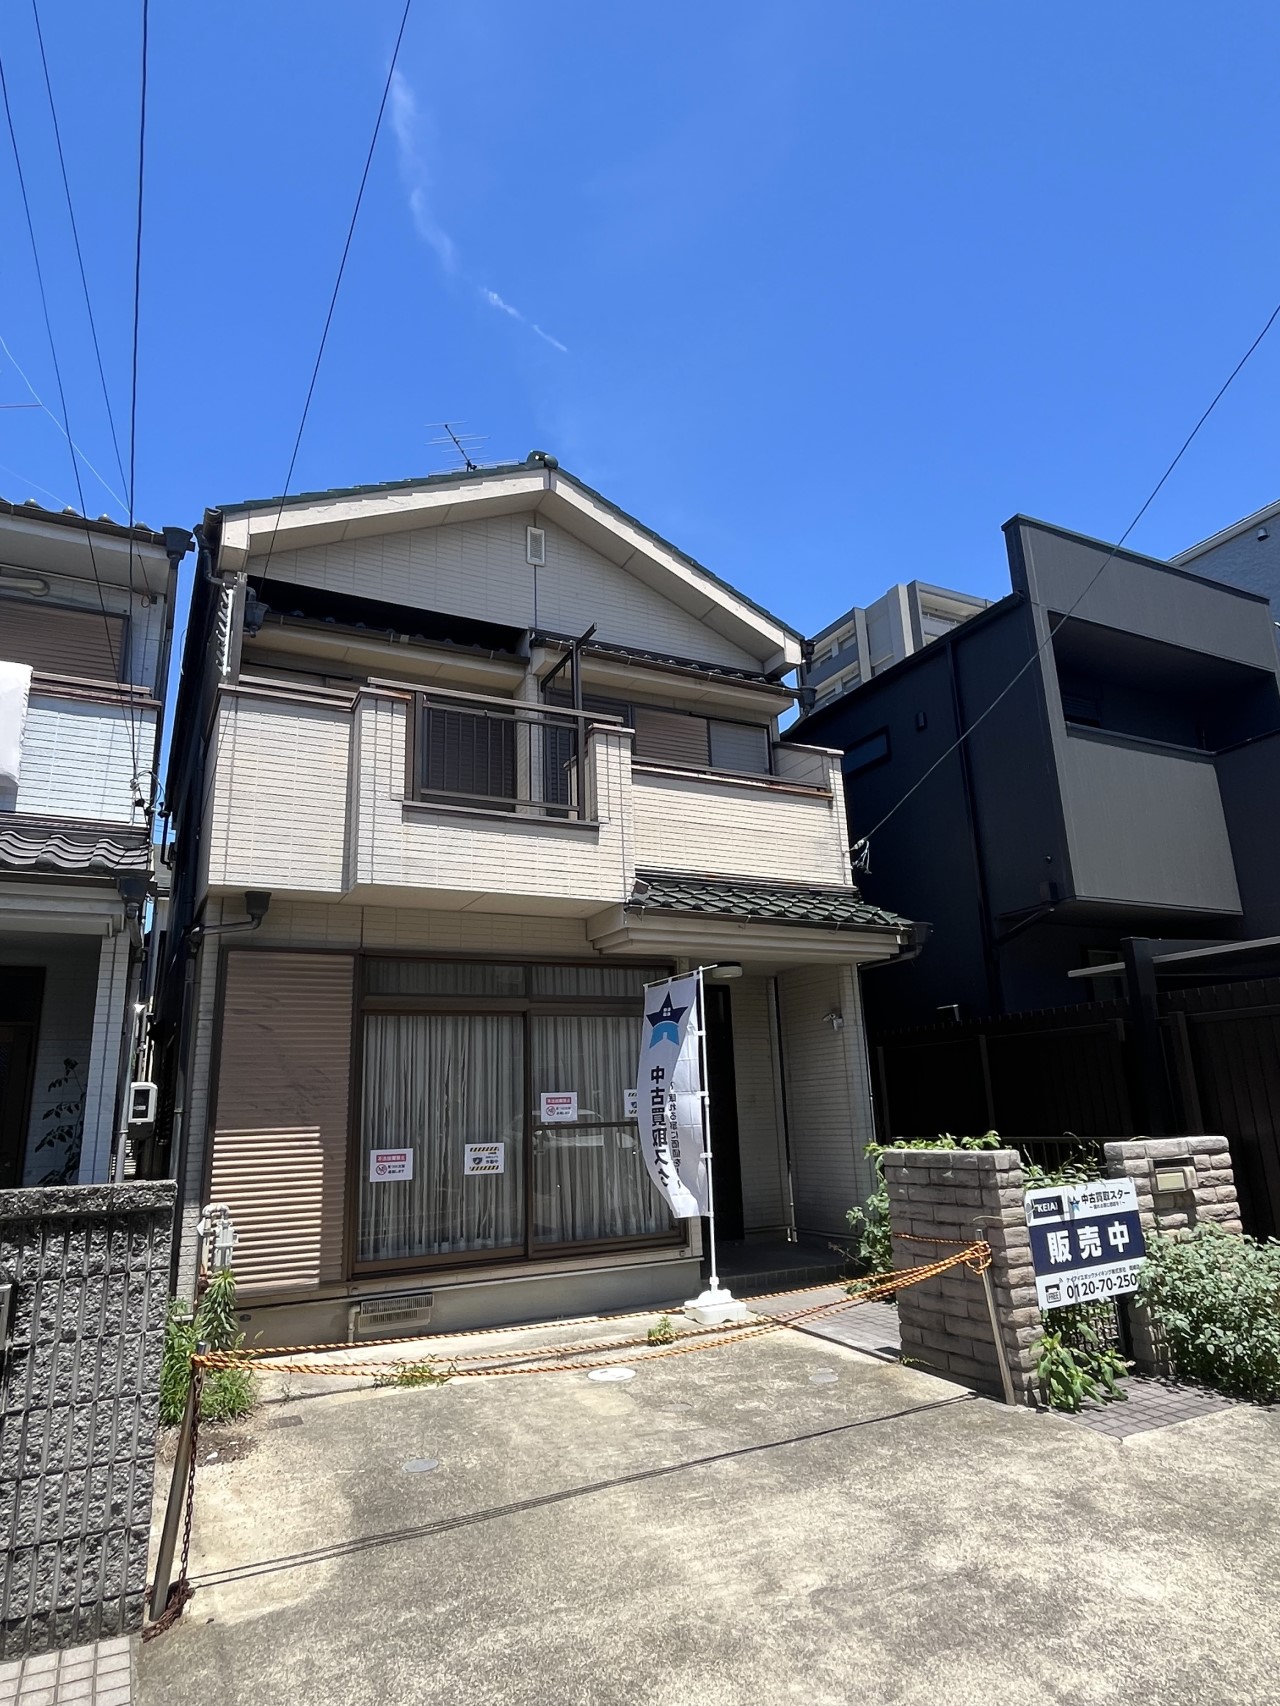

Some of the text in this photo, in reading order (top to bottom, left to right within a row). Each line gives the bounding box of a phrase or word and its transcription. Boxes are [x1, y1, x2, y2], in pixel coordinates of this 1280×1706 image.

[1081, 1189, 1130, 1205] 中古買取スター
[1046, 1221, 1130, 1264] 販売中
[1066, 1273, 1137, 1299] 0120-70-250
